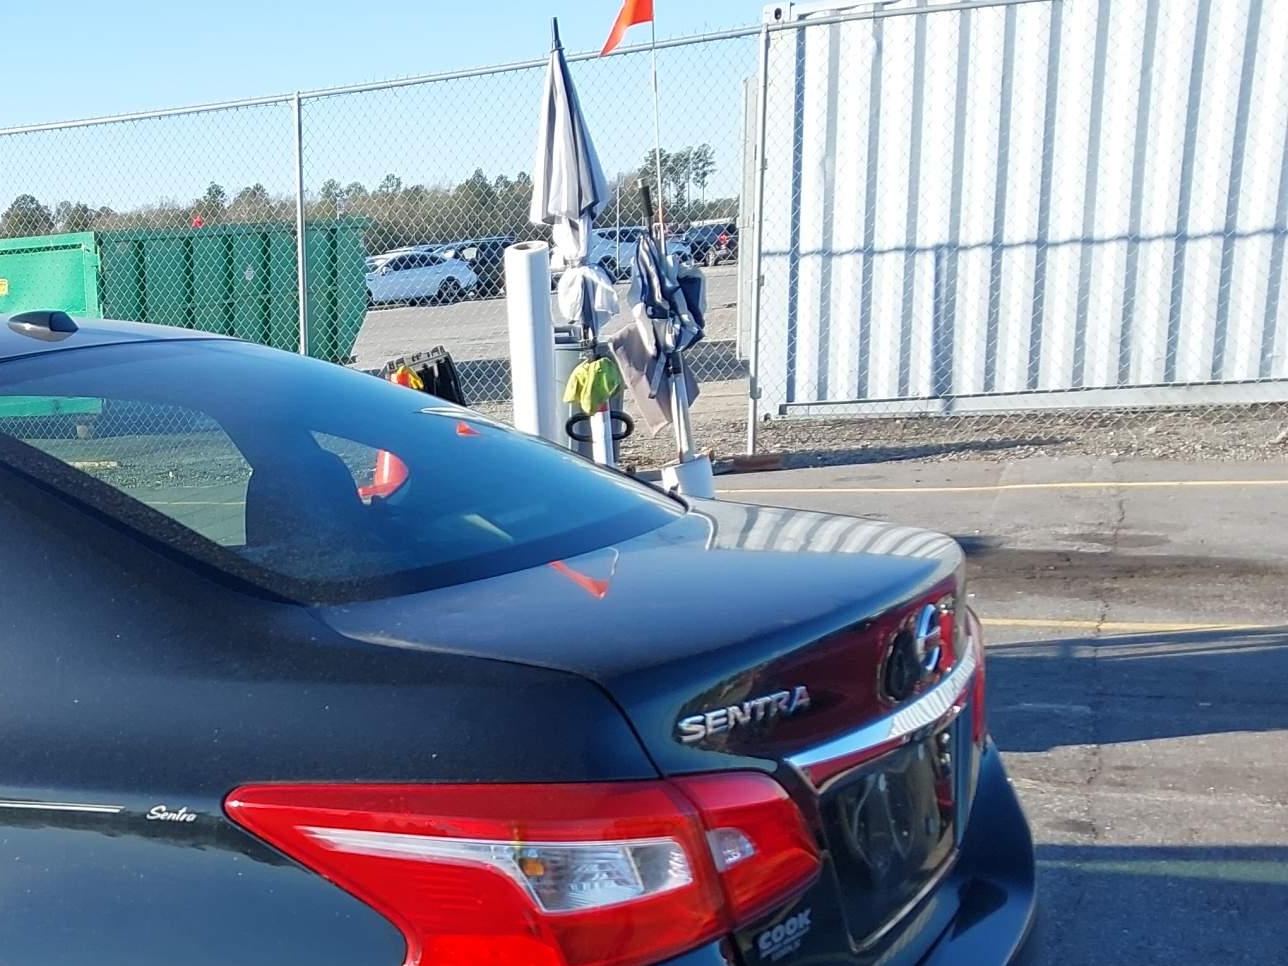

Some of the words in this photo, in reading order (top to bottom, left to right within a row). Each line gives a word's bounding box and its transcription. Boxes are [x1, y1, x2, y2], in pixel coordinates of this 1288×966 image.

[677, 685, 811, 743] SENTRA
[145, 804, 198, 823] Sentra
[758, 908, 811, 950] COOK
